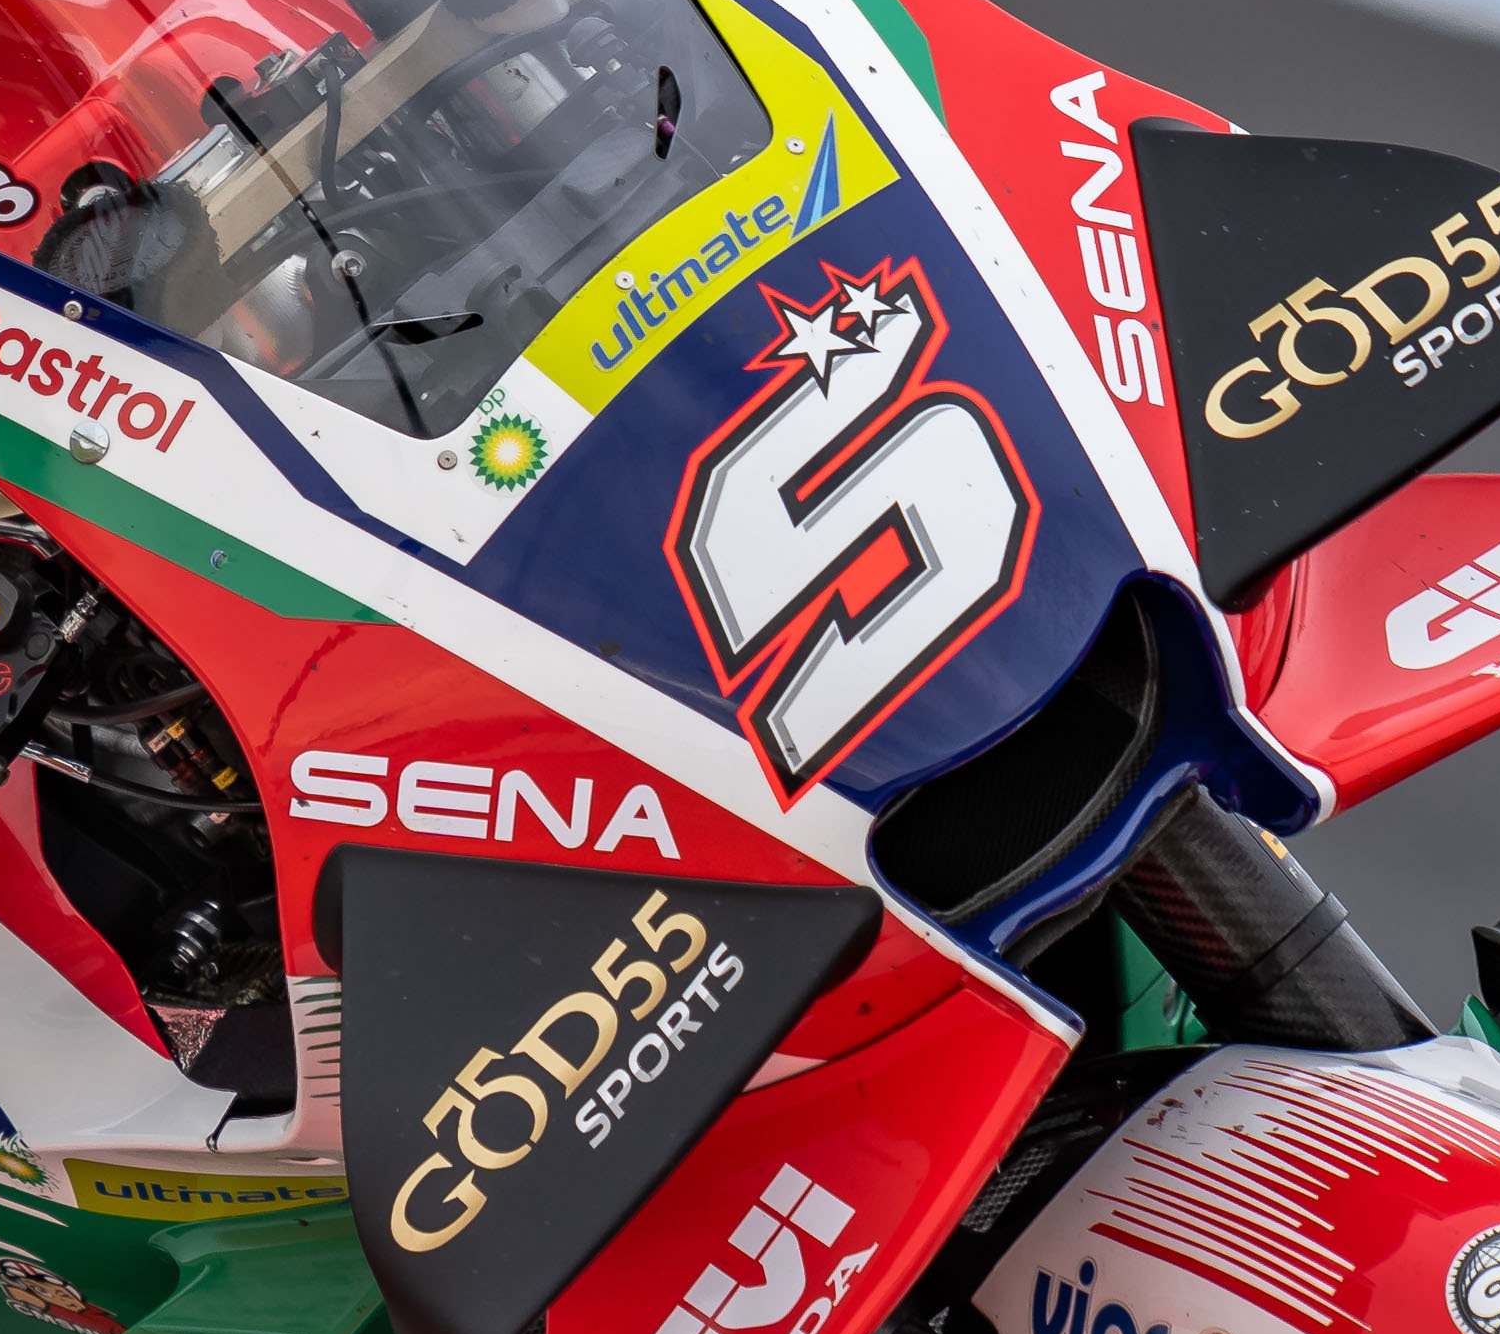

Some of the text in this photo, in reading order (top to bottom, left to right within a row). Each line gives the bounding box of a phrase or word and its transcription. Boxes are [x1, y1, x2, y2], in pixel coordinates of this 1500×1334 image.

[590, 191, 788, 372] ultimate
[1049, 71, 1165, 407] SENA
[289, 750, 681, 860] SENA
[575, 942, 746, 1150] SPORTS
[93, 1177, 348, 1206] ultimate
